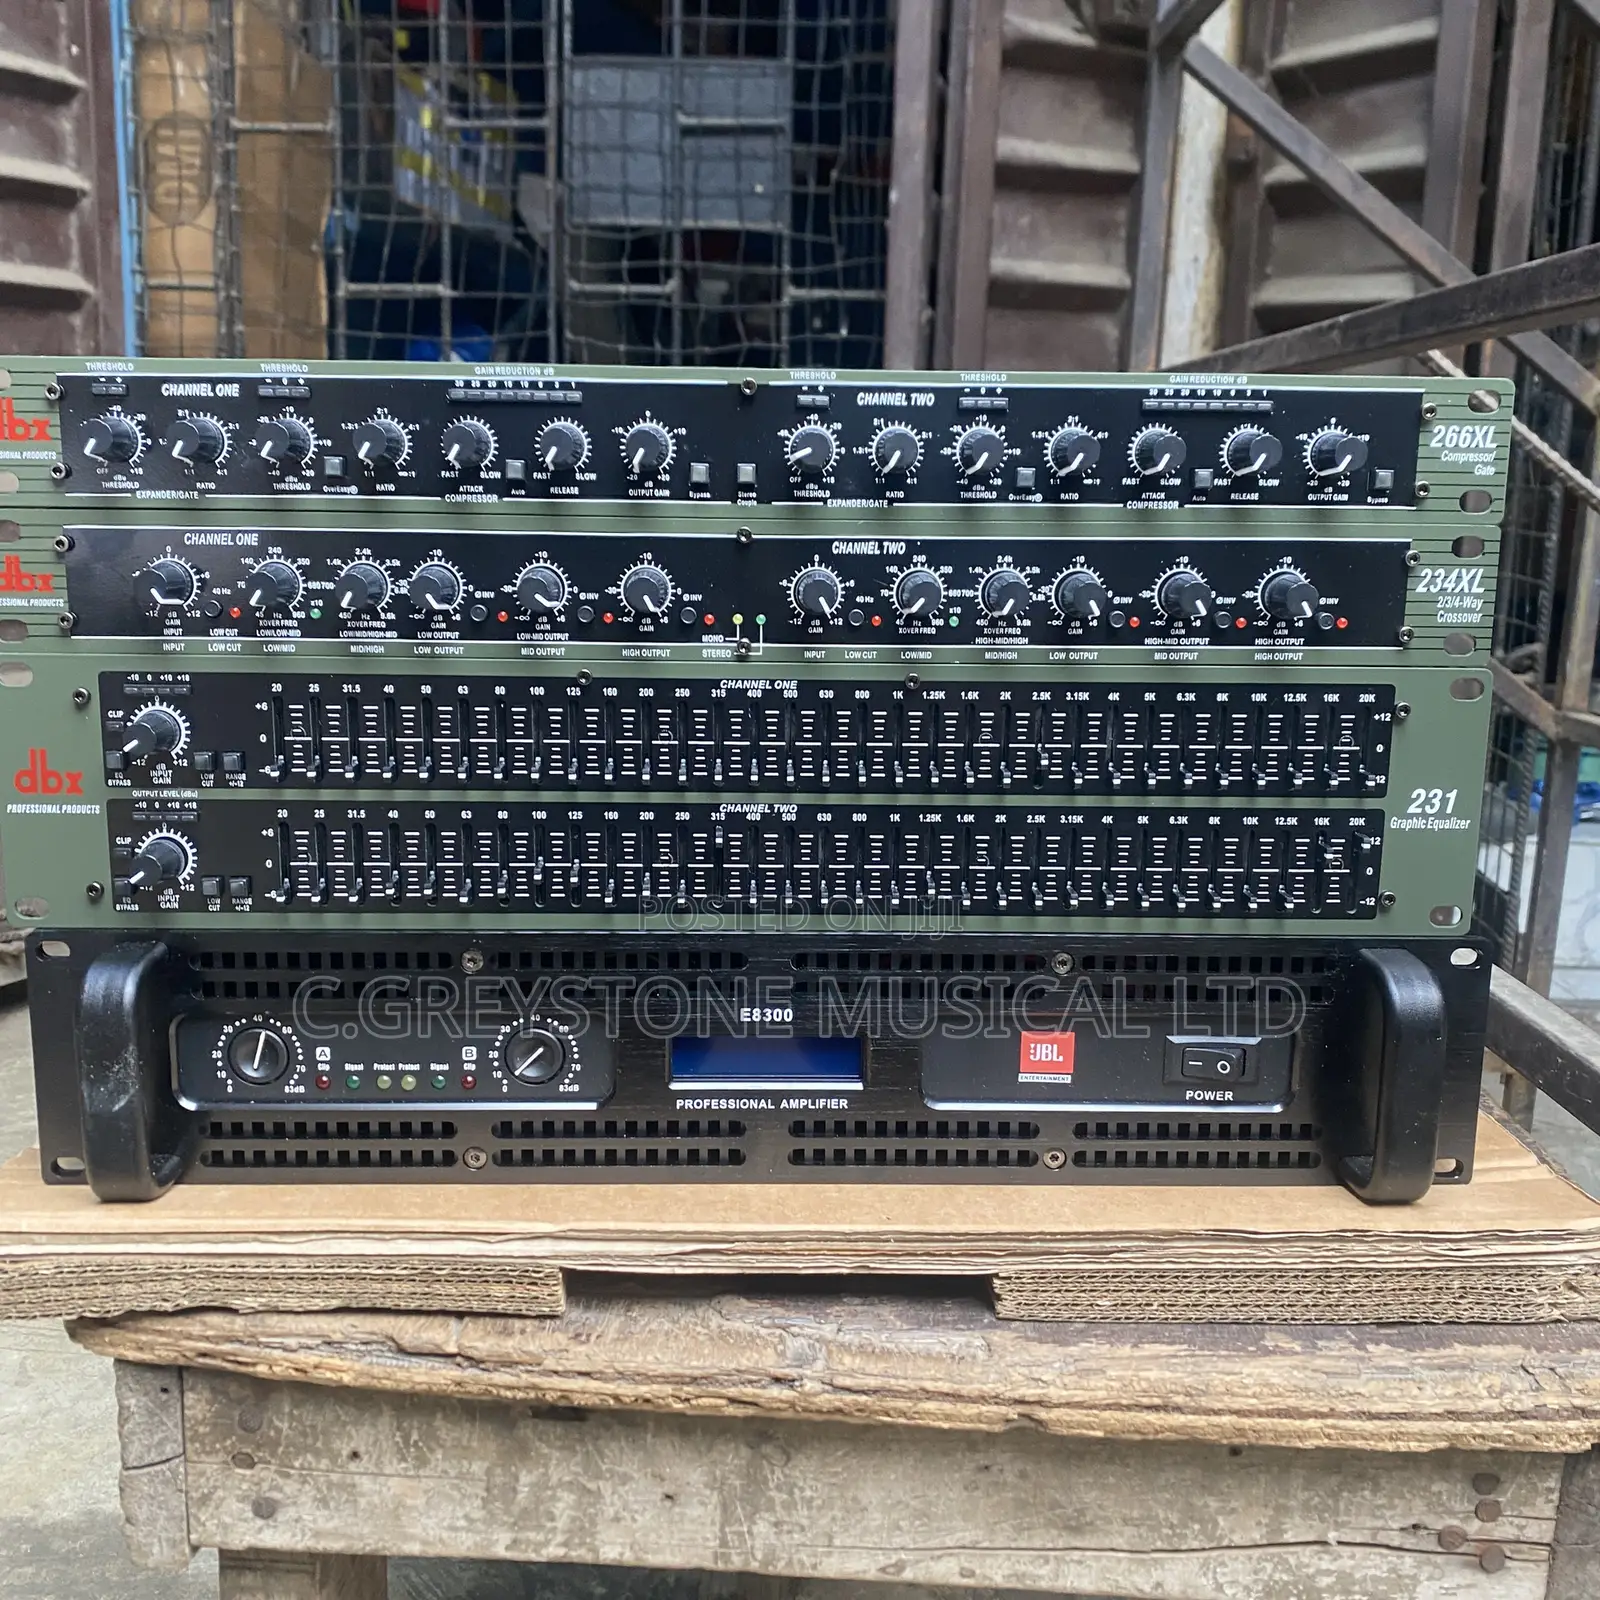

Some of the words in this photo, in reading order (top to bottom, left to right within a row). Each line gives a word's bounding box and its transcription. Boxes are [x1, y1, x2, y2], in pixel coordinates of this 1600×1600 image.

[85, 362, 134, 370] THRESHOLD
[260, 363, 308, 372] THRESHOLD
[474, 366, 494, 374] GAIN
[495, 366, 540, 375] REDUCTION
[790, 372, 836, 380] THRESHOLD
[1189, 376, 1234, 384] REDUCTION
[162, 384, 214, 396] CHANNEL
[216, 384, 240, 396] ONE
[857, 392, 908, 406] CHANNEL
[910, 393, 934, 406] TWO
[0, 397, 52, 440] bx
[1430, 425, 1498, 448] 266XL
[1474, 464, 1496, 476] Gate
[102, 481, 140, 489] THRESHOLD
[136, 490, 198, 499] EXPANDER/GATE
[550, 486, 578, 494] RELEASE
[445, 494, 498, 504] COMPRESSOR
[827, 499, 888, 508] EXPANDER/GATE
[1126, 500, 1179, 510] COMPRESSOR
[184, 533, 234, 545] CHANNEL
[236, 533, 258, 546] ONE
[832, 541, 880, 554] CHANNEL
[883, 542, 906, 554] TWO
[1416, 568, 1485, 593] 234XL
[1436, 596, 1484, 611] 2/3/4-Way
[1437, 610, 1482, 622] Crossover
[702, 634, 724, 642] MONO
[163, 643, 185, 651] INPUT
[208, 643, 225, 651] LOW
[227, 643, 242, 651] CUT
[264, 644, 296, 652] LOW/MID
[350, 645, 384, 653] MID/HIGH
[434, 646, 464, 654] OUTPUT
[536, 648, 566, 656] OUTPUT
[622, 648, 642, 657] HIGH
[644, 649, 670, 657] OUTPUT
[702, 649, 731, 658] STEREO
[845, 650, 860, 658] LOW
[985, 652, 1018, 660] MID/HIGH
[1169, 652, 1198, 660] OUTPUT
[720, 680, 772, 689] CHANNEL
[774, 680, 798, 689] ONE
[272, 684, 282, 692] 20
[309, 684, 320, 692] 25
[342, 684, 360, 692] 31.5
[384, 684, 394, 693] 40
[421, 685, 431, 694] 50
[458, 686, 468, 694] 63
[495, 686, 505, 694] 80
[530, 686, 544, 695] 100
[566, 687, 580, 696] 125
[603, 688, 617, 696] 160
[639, 688, 654, 696] 200
[675, 688, 690, 697] 250
[712, 689, 726, 697] 315
[747, 689, 762, 698] 400
[784, 690, 798, 698] 500
[819, 690, 834, 698] 630
[855, 690, 870, 698] 800
[893, 691, 903, 699] 1K
[922, 691, 945, 699] 1.25K
[961, 691, 979, 700] 1.6K
[1000, 692, 1011, 700] 2K
[1032, 692, 1050, 700] 2.5K
[1066, 692, 1089, 700] 3.15K
[1108, 692, 1120, 700] 4K
[1144, 692, 1156, 701] 5K
[1176, 693, 1196, 701] 6.3K
[1216, 693, 1228, 701] 8K
[1251, 693, 1267, 702] 10K
[1284, 694, 1306, 702] 12.5K
[1324, 694, 1340, 702] 16K
[1359, 694, 1376, 702] 20K
[14, 748, 84, 795] dbx
[181, 790, 198, 798] (dBu)
[1407, 788, 1458, 814] 231
[7, 804, 60, 814] PROFESSIONAL
[62, 804, 100, 814] PRODUCTS
[720, 804, 770, 812] CHANNEL
[774, 804, 798, 812] TWO
[1390, 816, 1426, 831] Graphic
[1427, 817, 1470, 831] Equalizer
[740, 1008, 793, 1022] E8300
[1030, 1043, 1063, 1062] JBL
[318, 1063, 330, 1071] Clip
[344, 1063, 364, 1071] Signal
[430, 1063, 449, 1071] Signal
[1186, 1090, 1233, 1100] POWER
[676, 1099, 775, 1109] PROFESSIONAL
[780, 1099, 848, 1110] AMPLIFIER
